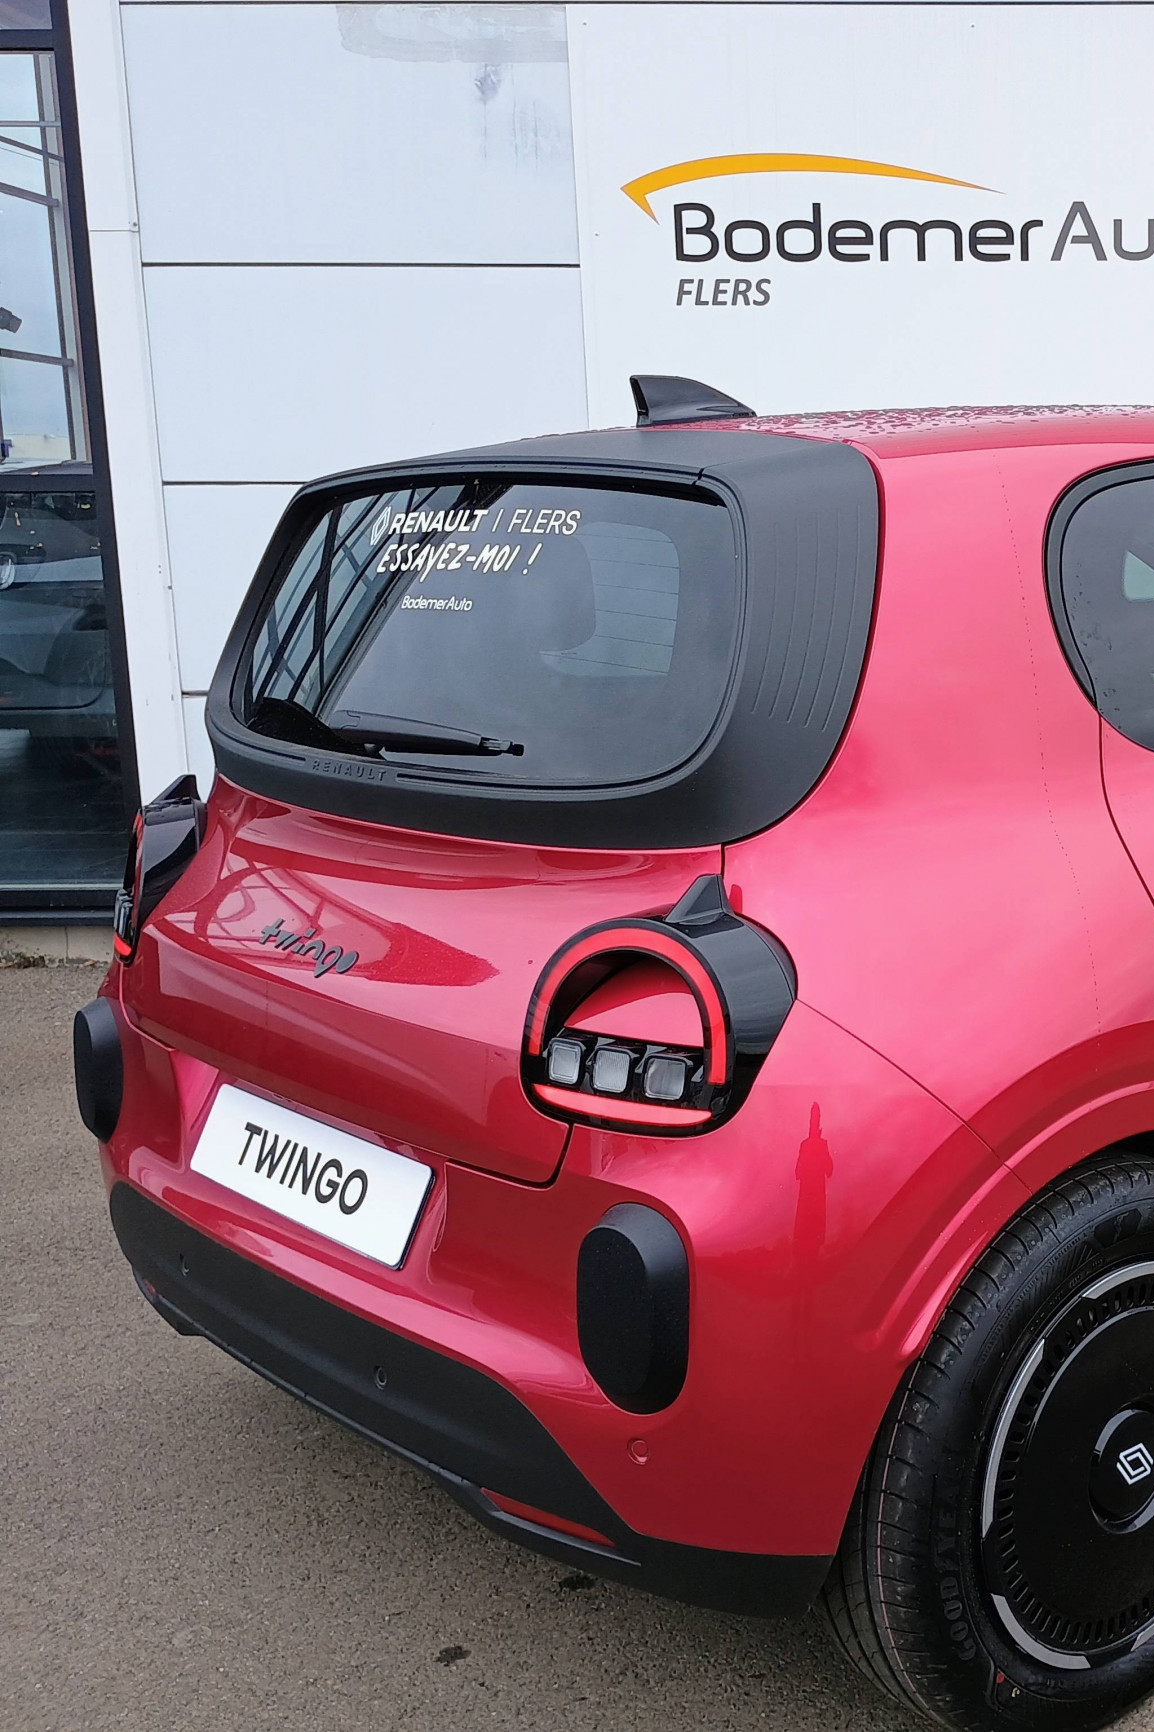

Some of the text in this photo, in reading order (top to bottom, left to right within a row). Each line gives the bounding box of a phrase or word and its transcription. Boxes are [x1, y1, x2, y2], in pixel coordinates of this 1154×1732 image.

[676, 279, 771, 306] FLERS
[388, 509, 489, 535] RENAULT
[507, 508, 582, 536] FLERS
[376, 541, 521, 583] ESSAYEZ-MOI
[401, 595, 473, 611] BodemerAuto
[312, 759, 387, 782] RENAULT
[238, 1121, 369, 1216] TWINGO
